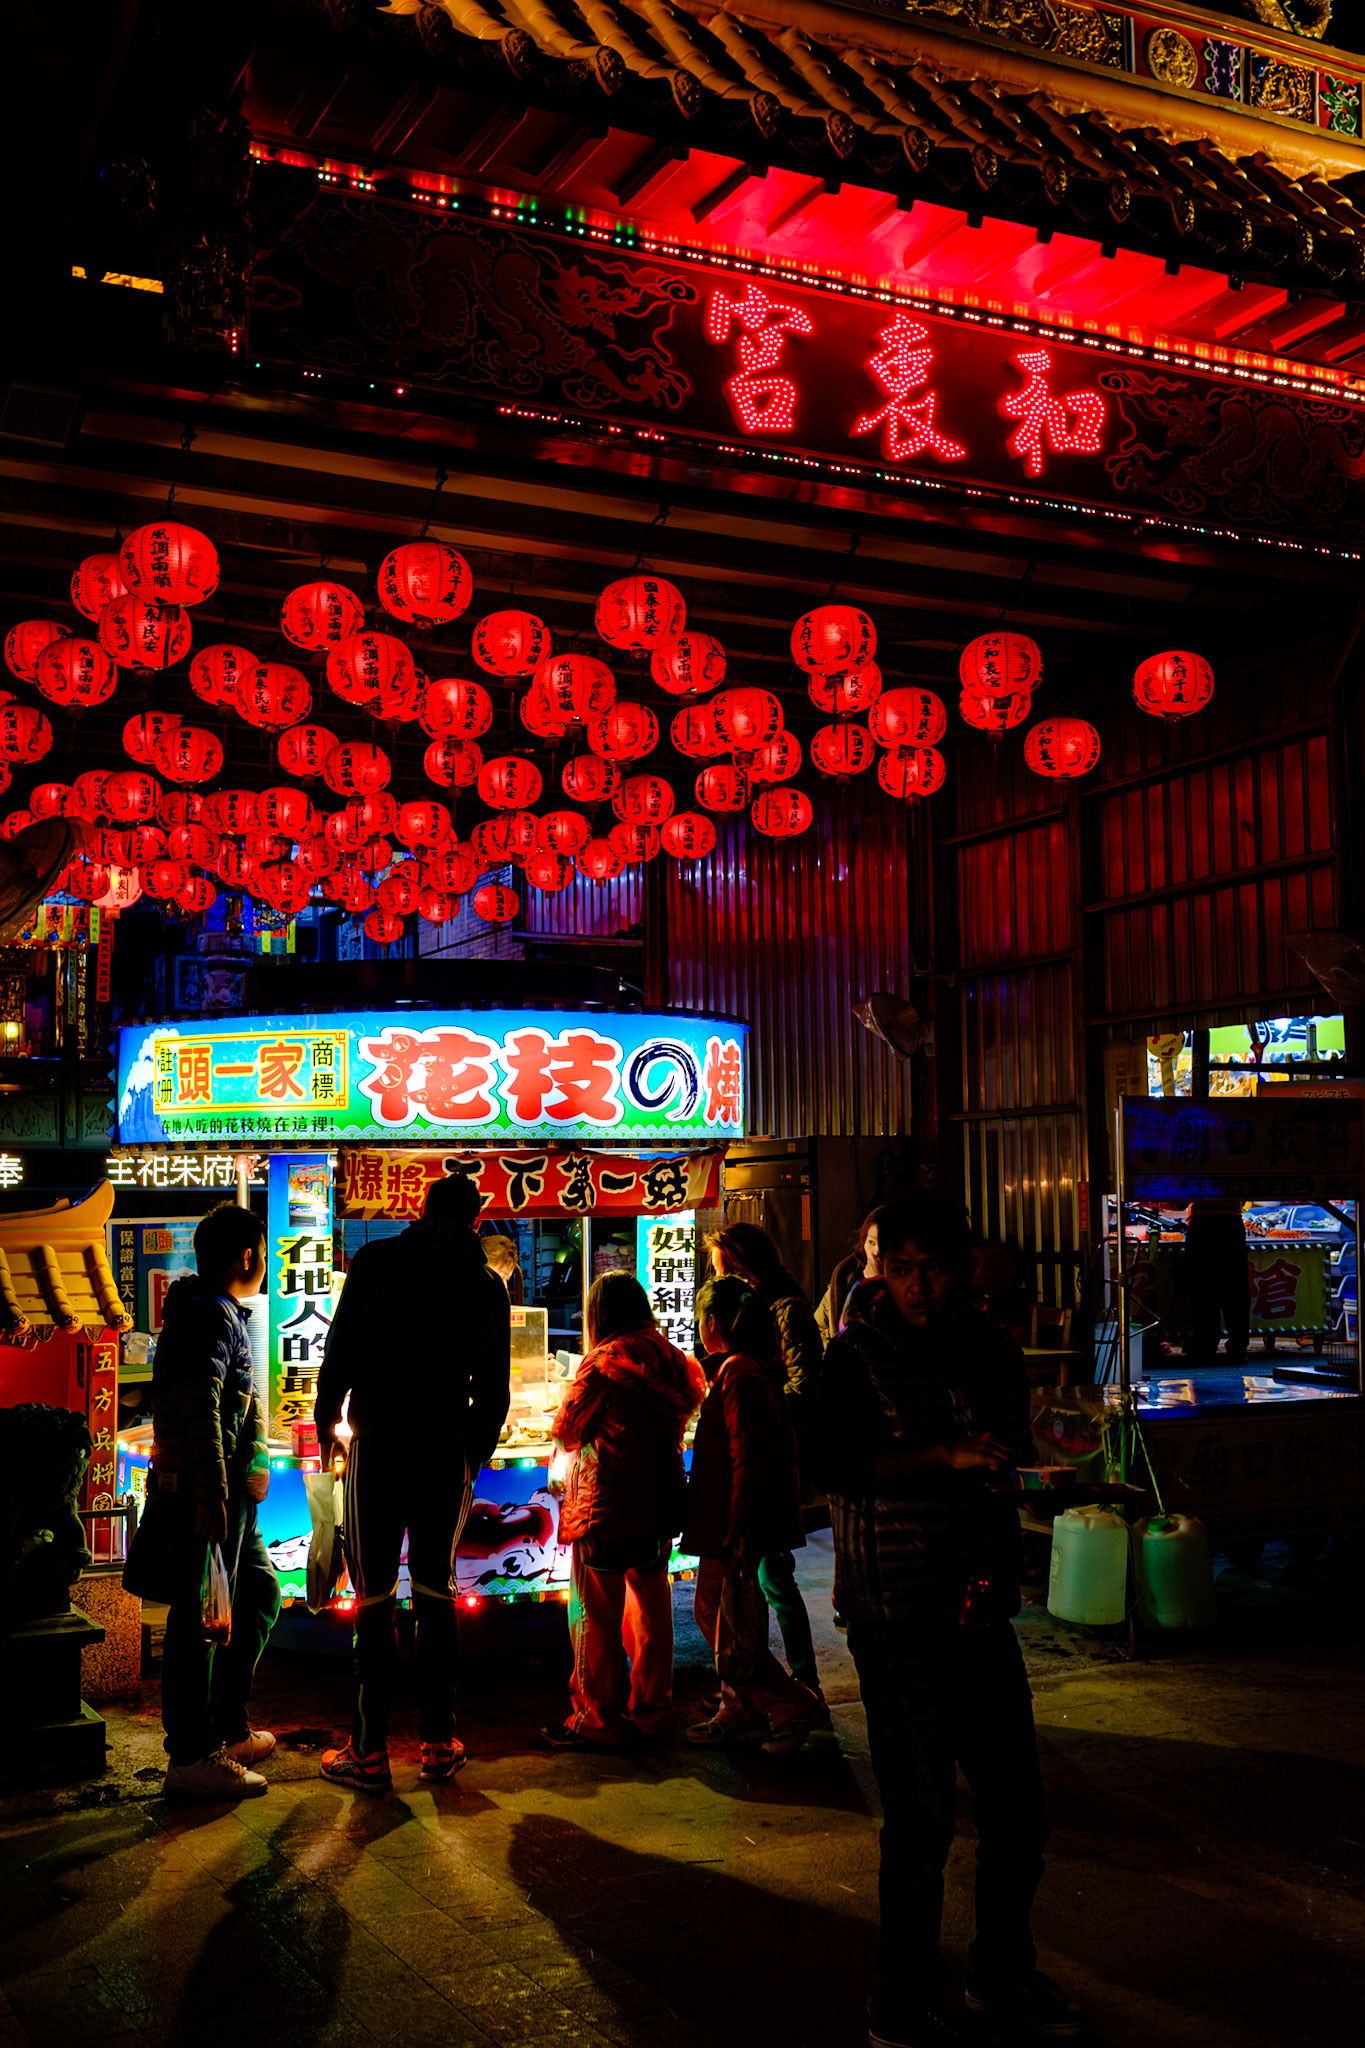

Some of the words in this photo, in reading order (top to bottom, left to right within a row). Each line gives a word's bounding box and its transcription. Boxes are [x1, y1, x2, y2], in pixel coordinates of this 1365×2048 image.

[150, 528, 173, 589] 風調雨順
[384, 552, 409, 609] 風調雨順
[440, 547, 463, 607] 朱府千歲
[142, 602, 160, 653] 泰民安
[326, 593, 343, 642] 風調雨順
[642, 582, 660, 637] 國泰民安
[76, 646, 95, 696] 風調雨順
[361, 637, 381, 689] 風調雨順
[677, 637, 692, 683] 風調雨順
[983, 648, 1002, 688] 和衷宮
[1170, 655, 1189, 704] 朱府千歲
[255, 668, 271, 715] 國泰民安
[462, 685, 478, 730] 國泰民安
[556, 661, 574, 711] 風調雨順
[4, 710, 20, 752] 風調雨順
[914, 695, 933, 741] 國泰民安
[178, 731, 192, 771] 國泰民安
[306, 729, 317, 766] 國泰民安
[505, 761, 517, 799] 國泰民安
[311, 1040, 334, 1100] 商標
[366, 1031, 742, 1123] 花枝の燒
[161, 1116, 335, 1135] 在地人吃的花枝燒在這裡!
[652, 1227, 695, 1352] 媒體網路
